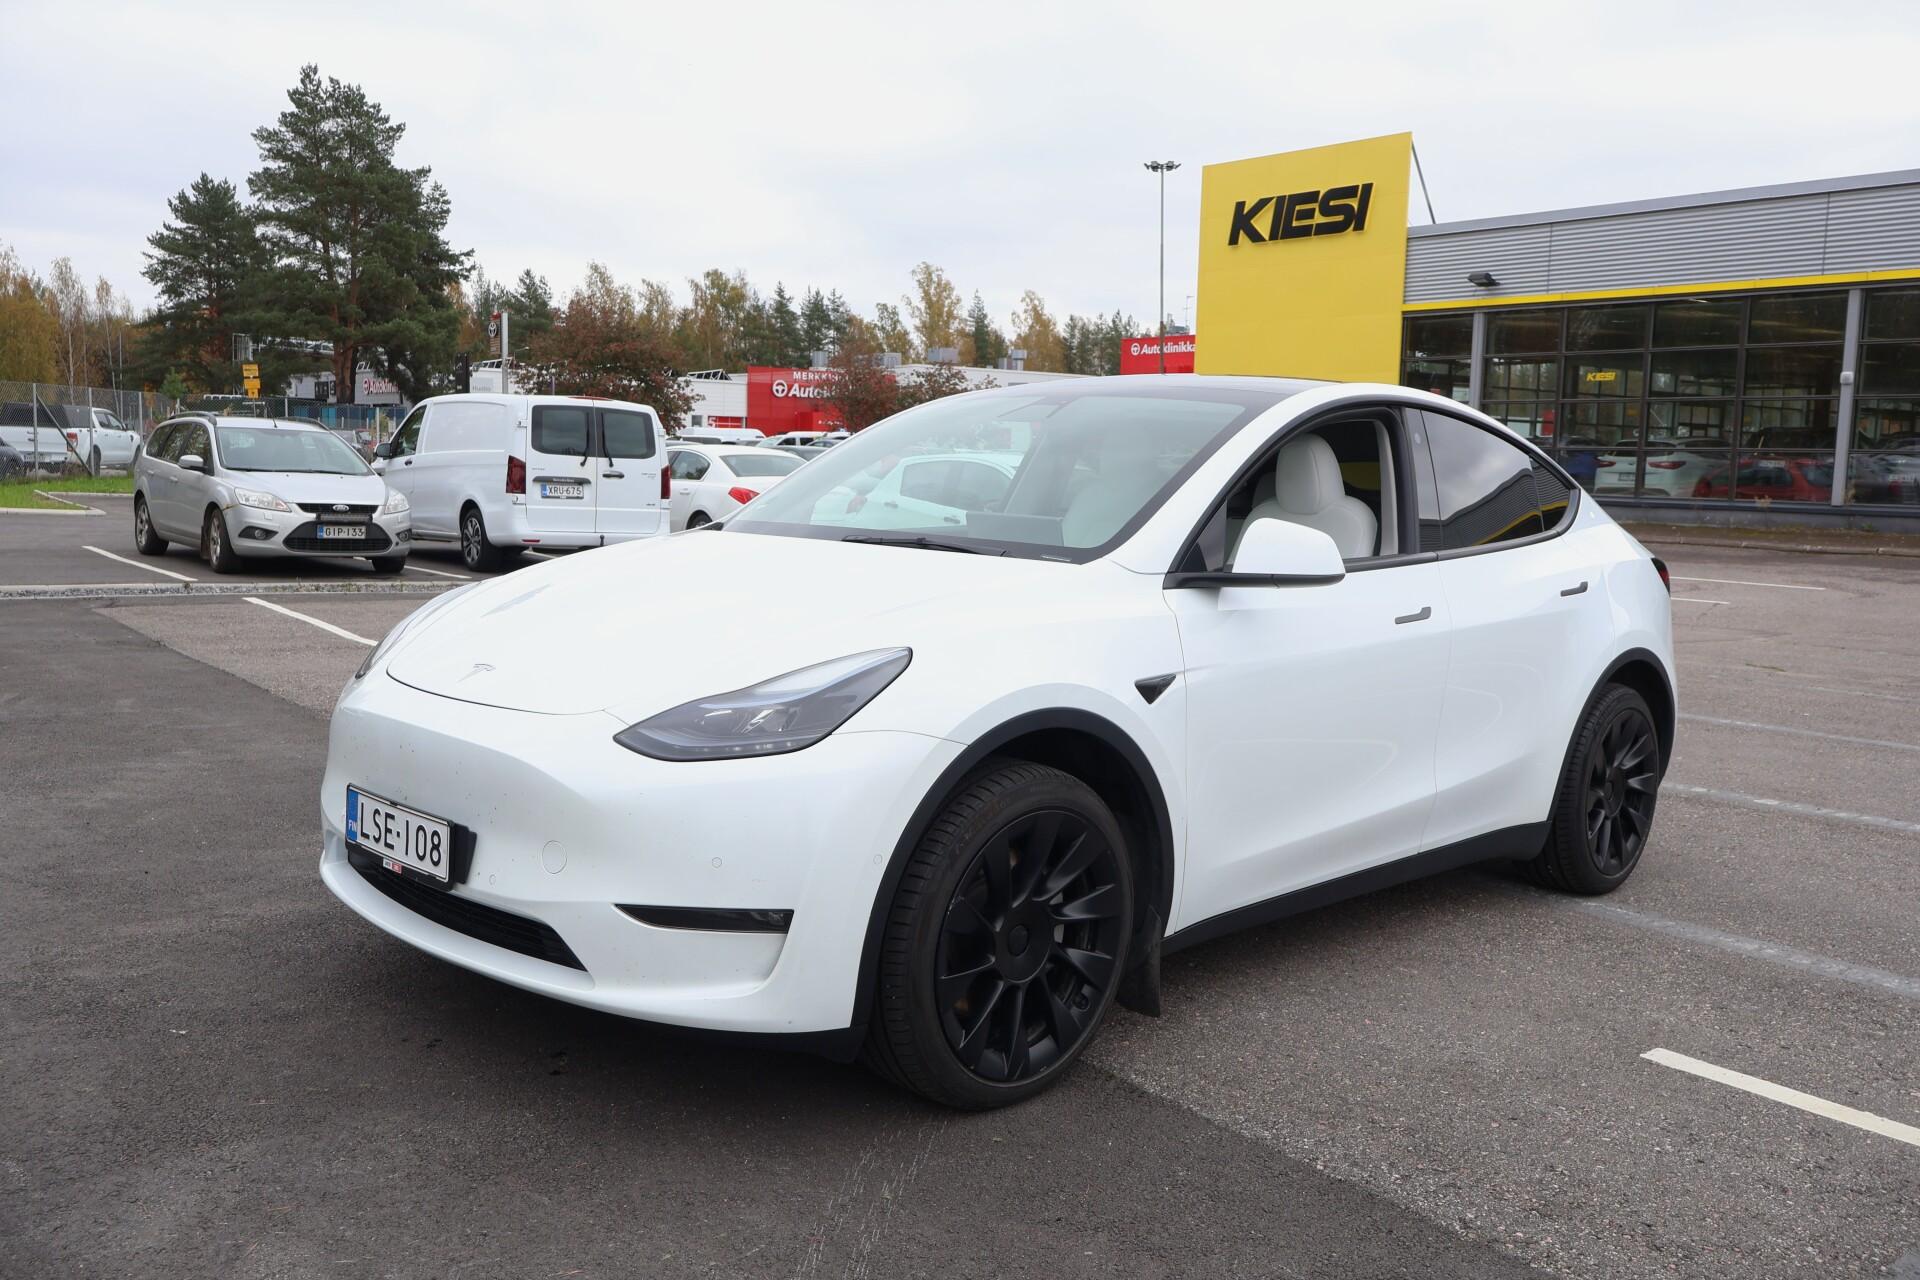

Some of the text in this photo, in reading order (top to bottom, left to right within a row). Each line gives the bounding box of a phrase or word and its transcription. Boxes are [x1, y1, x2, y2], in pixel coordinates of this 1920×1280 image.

[1228, 182, 1374, 246] KIESI
[548, 486, 582, 496] XRU-675
[325, 527, 364, 537] GIP-133
[348, 802, 441, 867] FIN LSE-108
